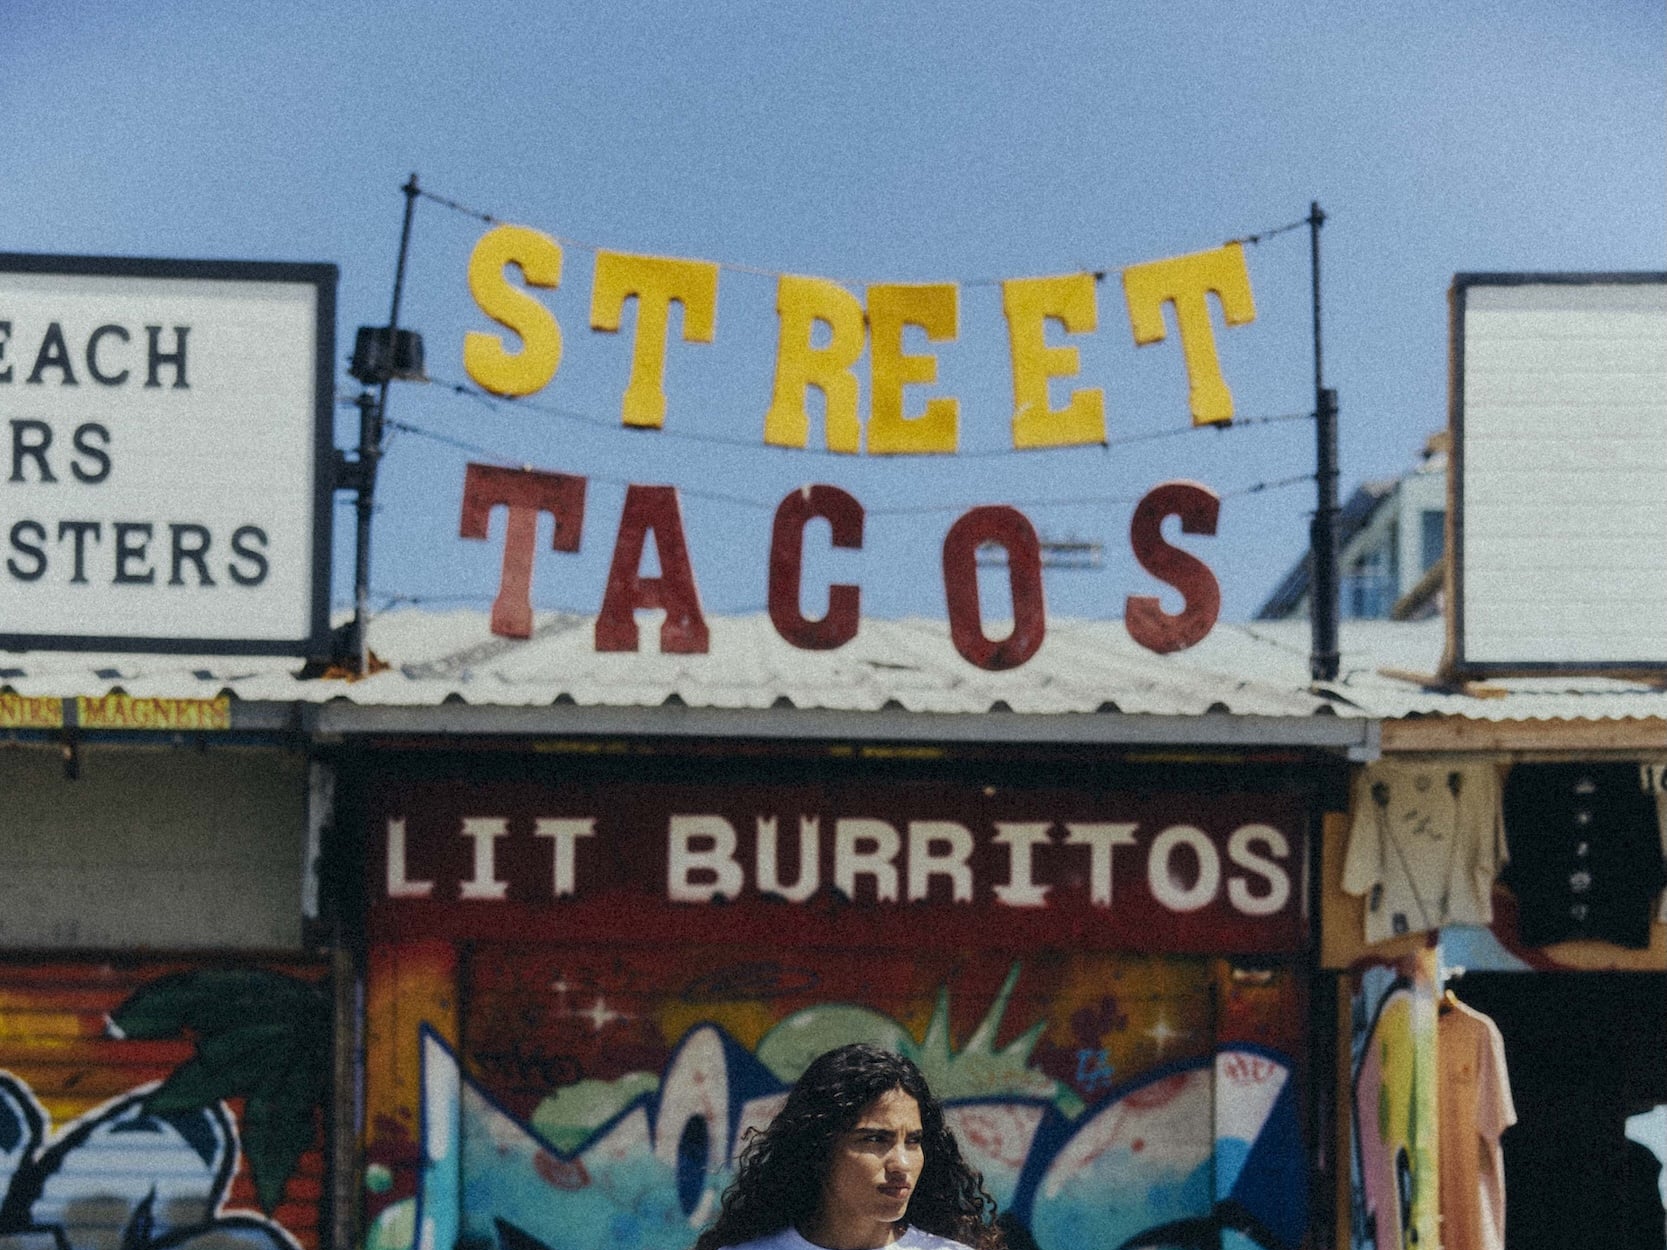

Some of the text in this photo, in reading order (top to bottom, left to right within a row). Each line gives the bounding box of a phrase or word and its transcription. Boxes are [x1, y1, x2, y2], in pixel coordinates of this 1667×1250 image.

[463, 224, 1256, 454] STREET
[9, 419, 112, 484] RS
[7, 520, 269, 586] STERS
[459, 463, 1222, 671] TACOS
[386, 815, 1292, 915] LIT BURRITOS
